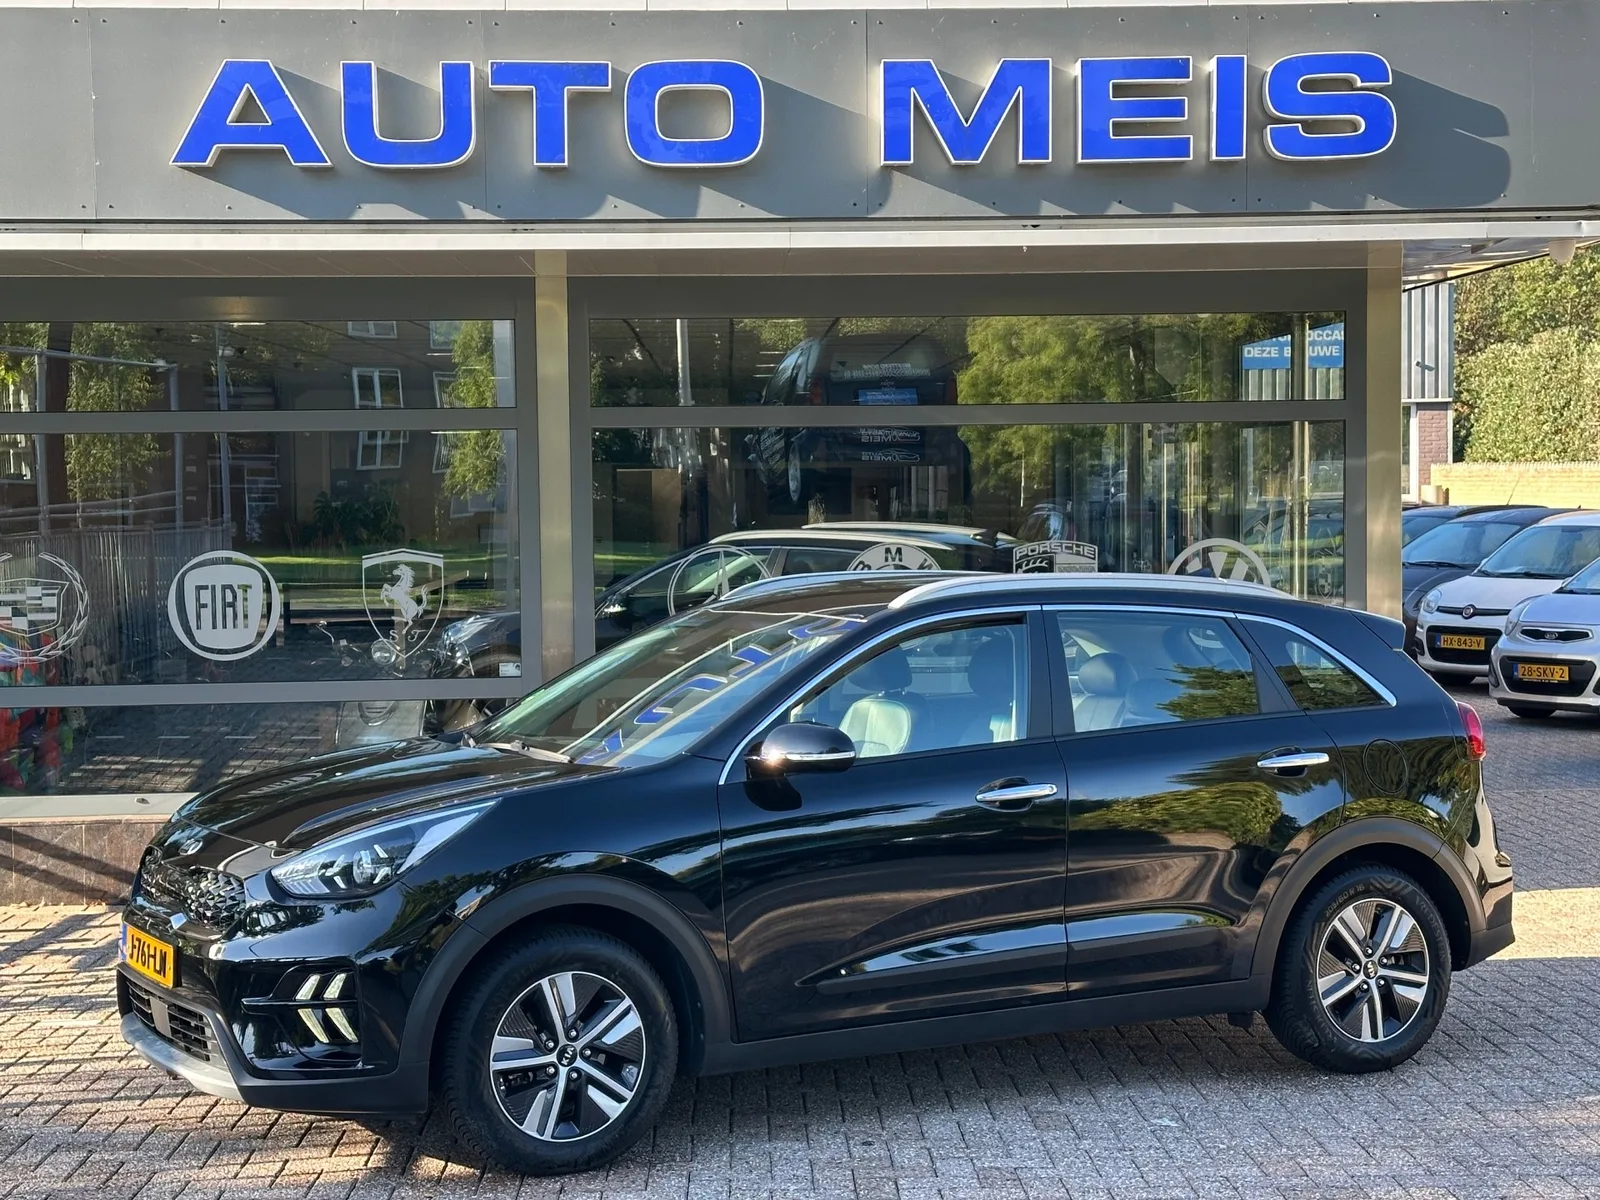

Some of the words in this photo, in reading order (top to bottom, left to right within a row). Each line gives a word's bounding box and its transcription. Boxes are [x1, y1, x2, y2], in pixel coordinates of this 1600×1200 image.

[169, 59, 765, 169] AUTO
[880, 51, 1398, 164] MEIS
[1244, 347, 1279, 358] DEZE
[1016, 542, 1095, 560] PORSCHE
[194, 584, 252, 630] FIAT
[1442, 638, 1482, 648] HX-843-V
[1521, 666, 1566, 679] 28-SKV-2
[129, 934, 167, 978] J-761-LN
[561, 1047, 575, 1066] KIA
